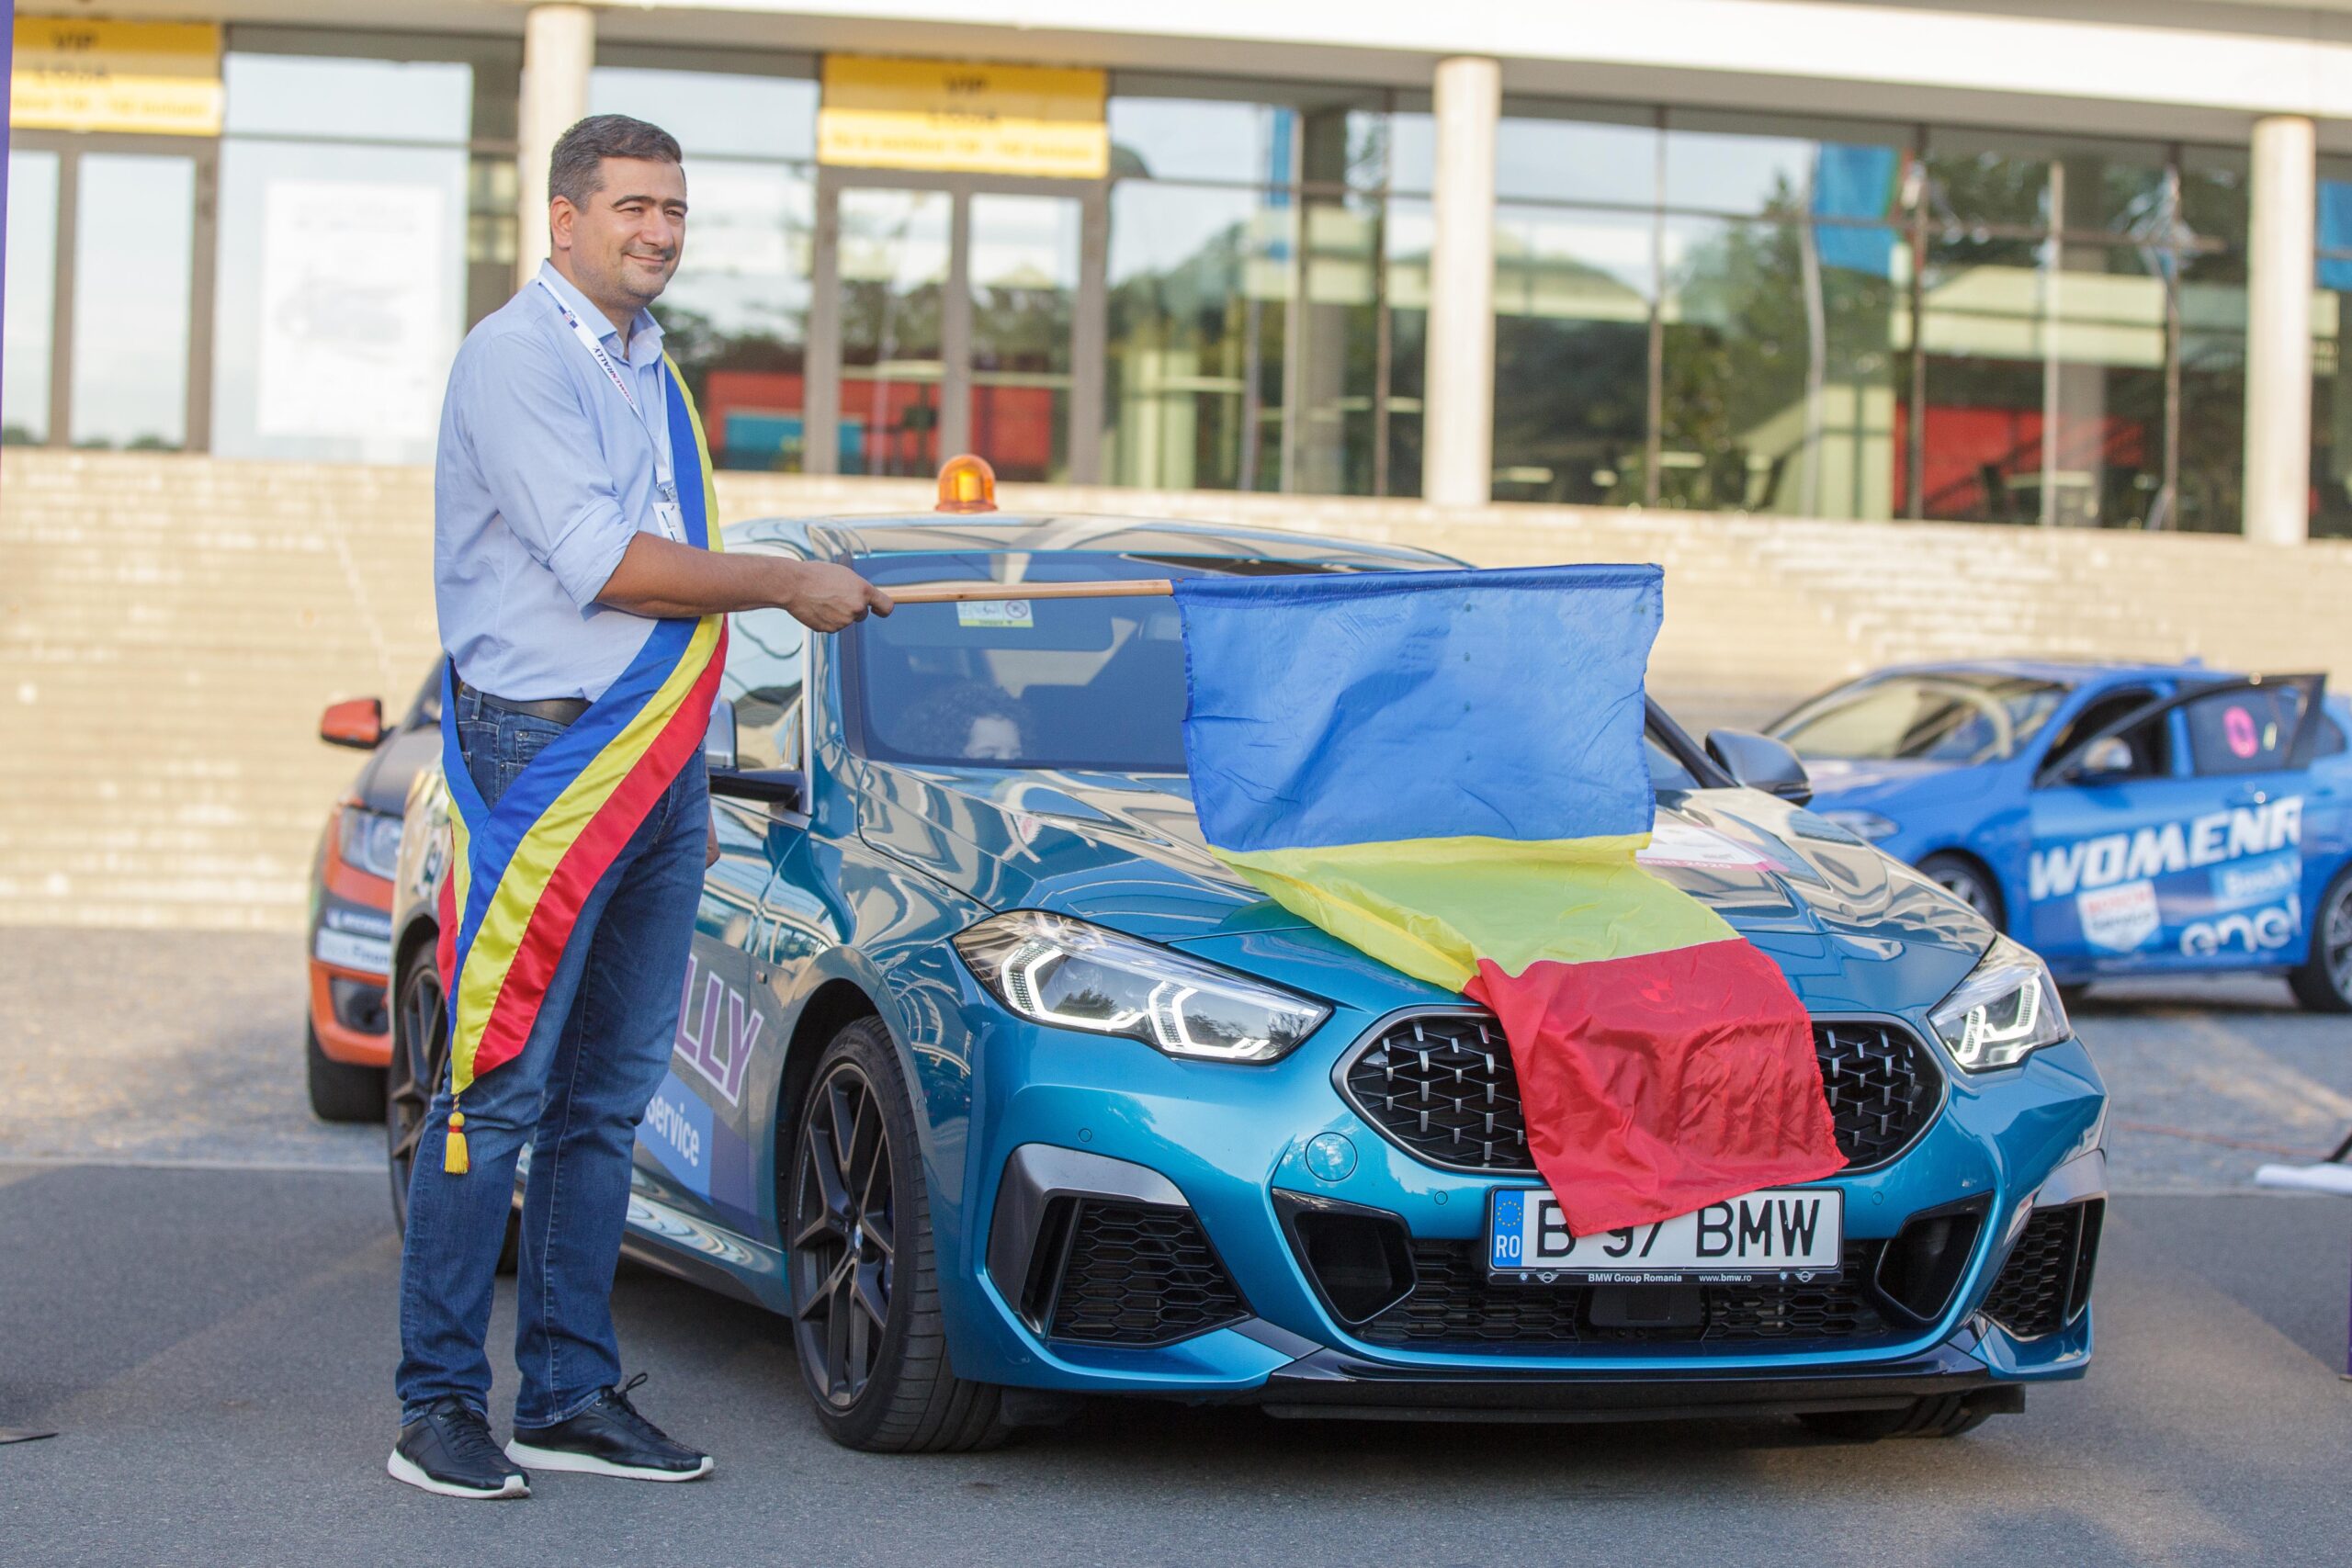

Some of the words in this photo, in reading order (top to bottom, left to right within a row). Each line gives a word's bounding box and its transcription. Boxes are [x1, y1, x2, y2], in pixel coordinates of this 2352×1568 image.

[646, 1095, 700, 1167] service
[1496, 1235, 1521, 1258] RO
[1537, 1200, 1577, 1258] B
[1696, 1199, 1820, 1258] BMW
[1588, 1273, 1612, 1282] BMW
[1613, 1273, 1642, 1284] Group
[1643, 1273, 1682, 1282] Romania
[1699, 1273, 1752, 1282] www.bmw.ro
